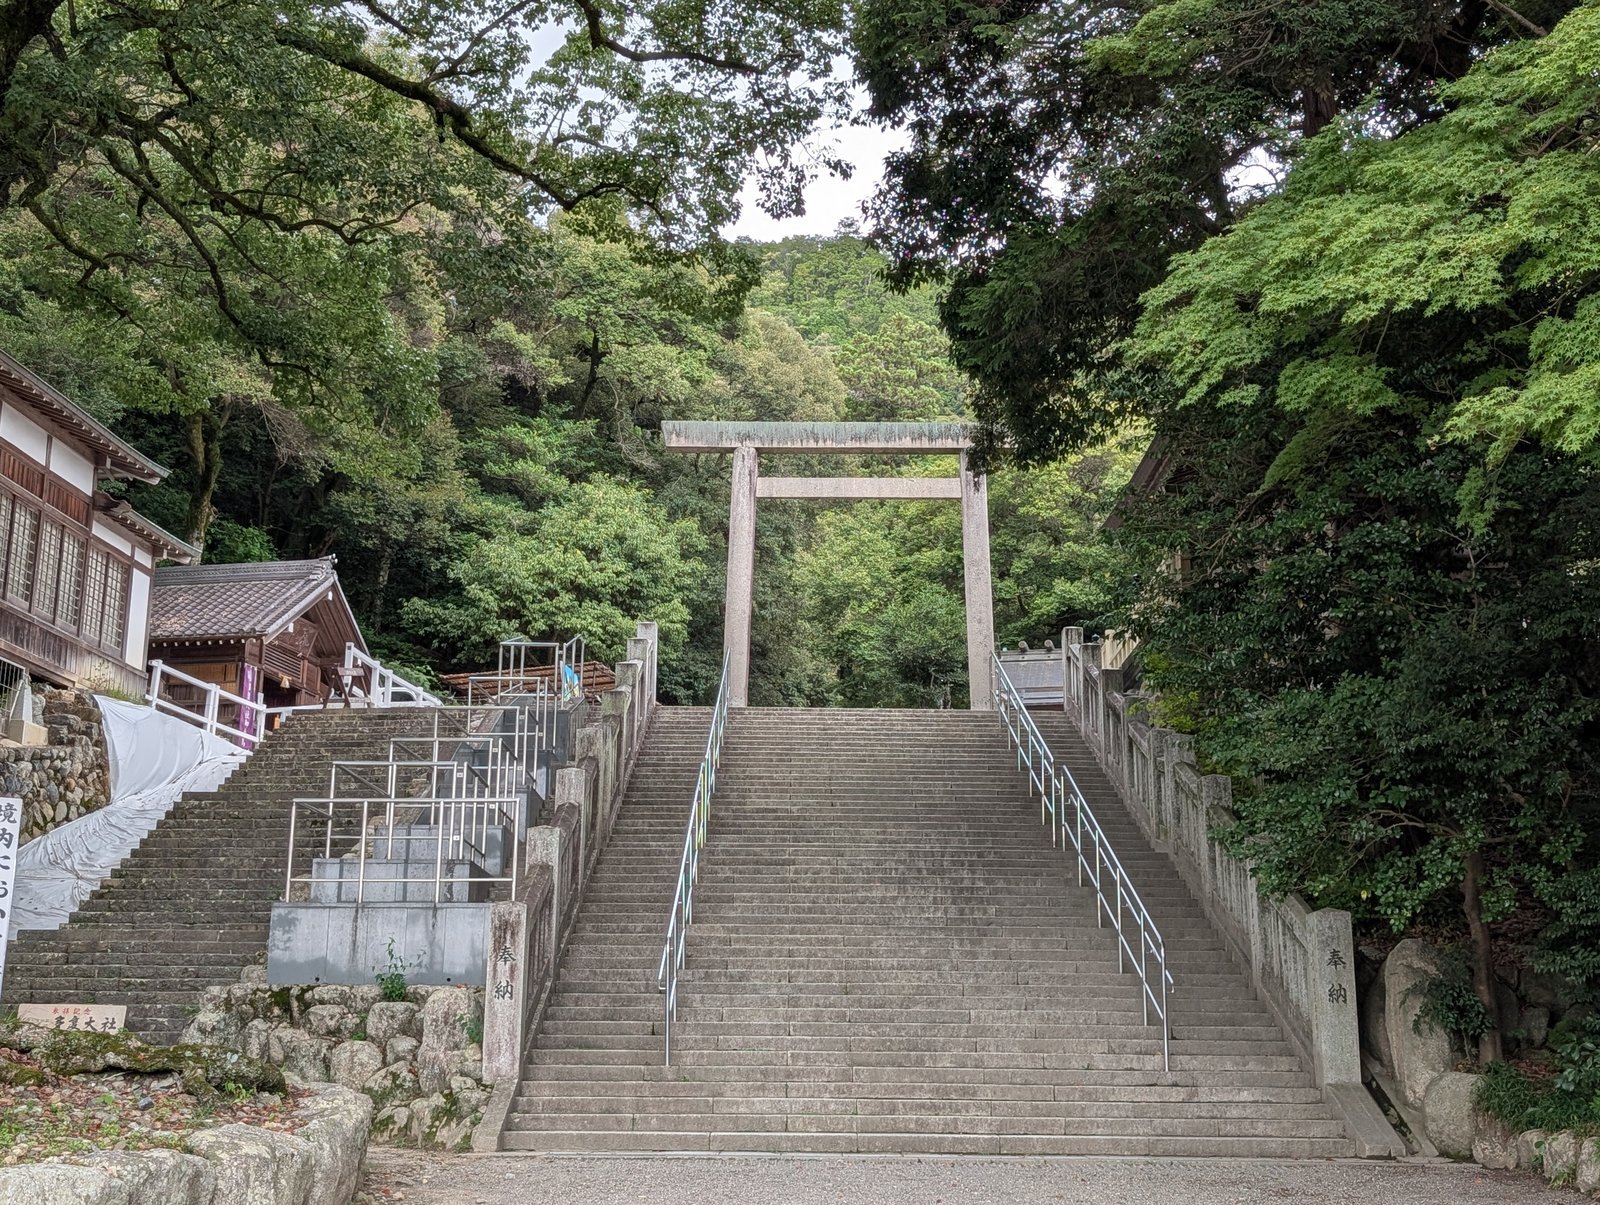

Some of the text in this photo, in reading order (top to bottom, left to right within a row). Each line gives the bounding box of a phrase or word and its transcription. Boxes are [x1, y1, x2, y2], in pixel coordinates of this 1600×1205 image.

[494, 945, 517, 1001] 奉納
[1326, 948, 1347, 1005] 奉納
[51, 1015, 117, 1032] 多度大社
